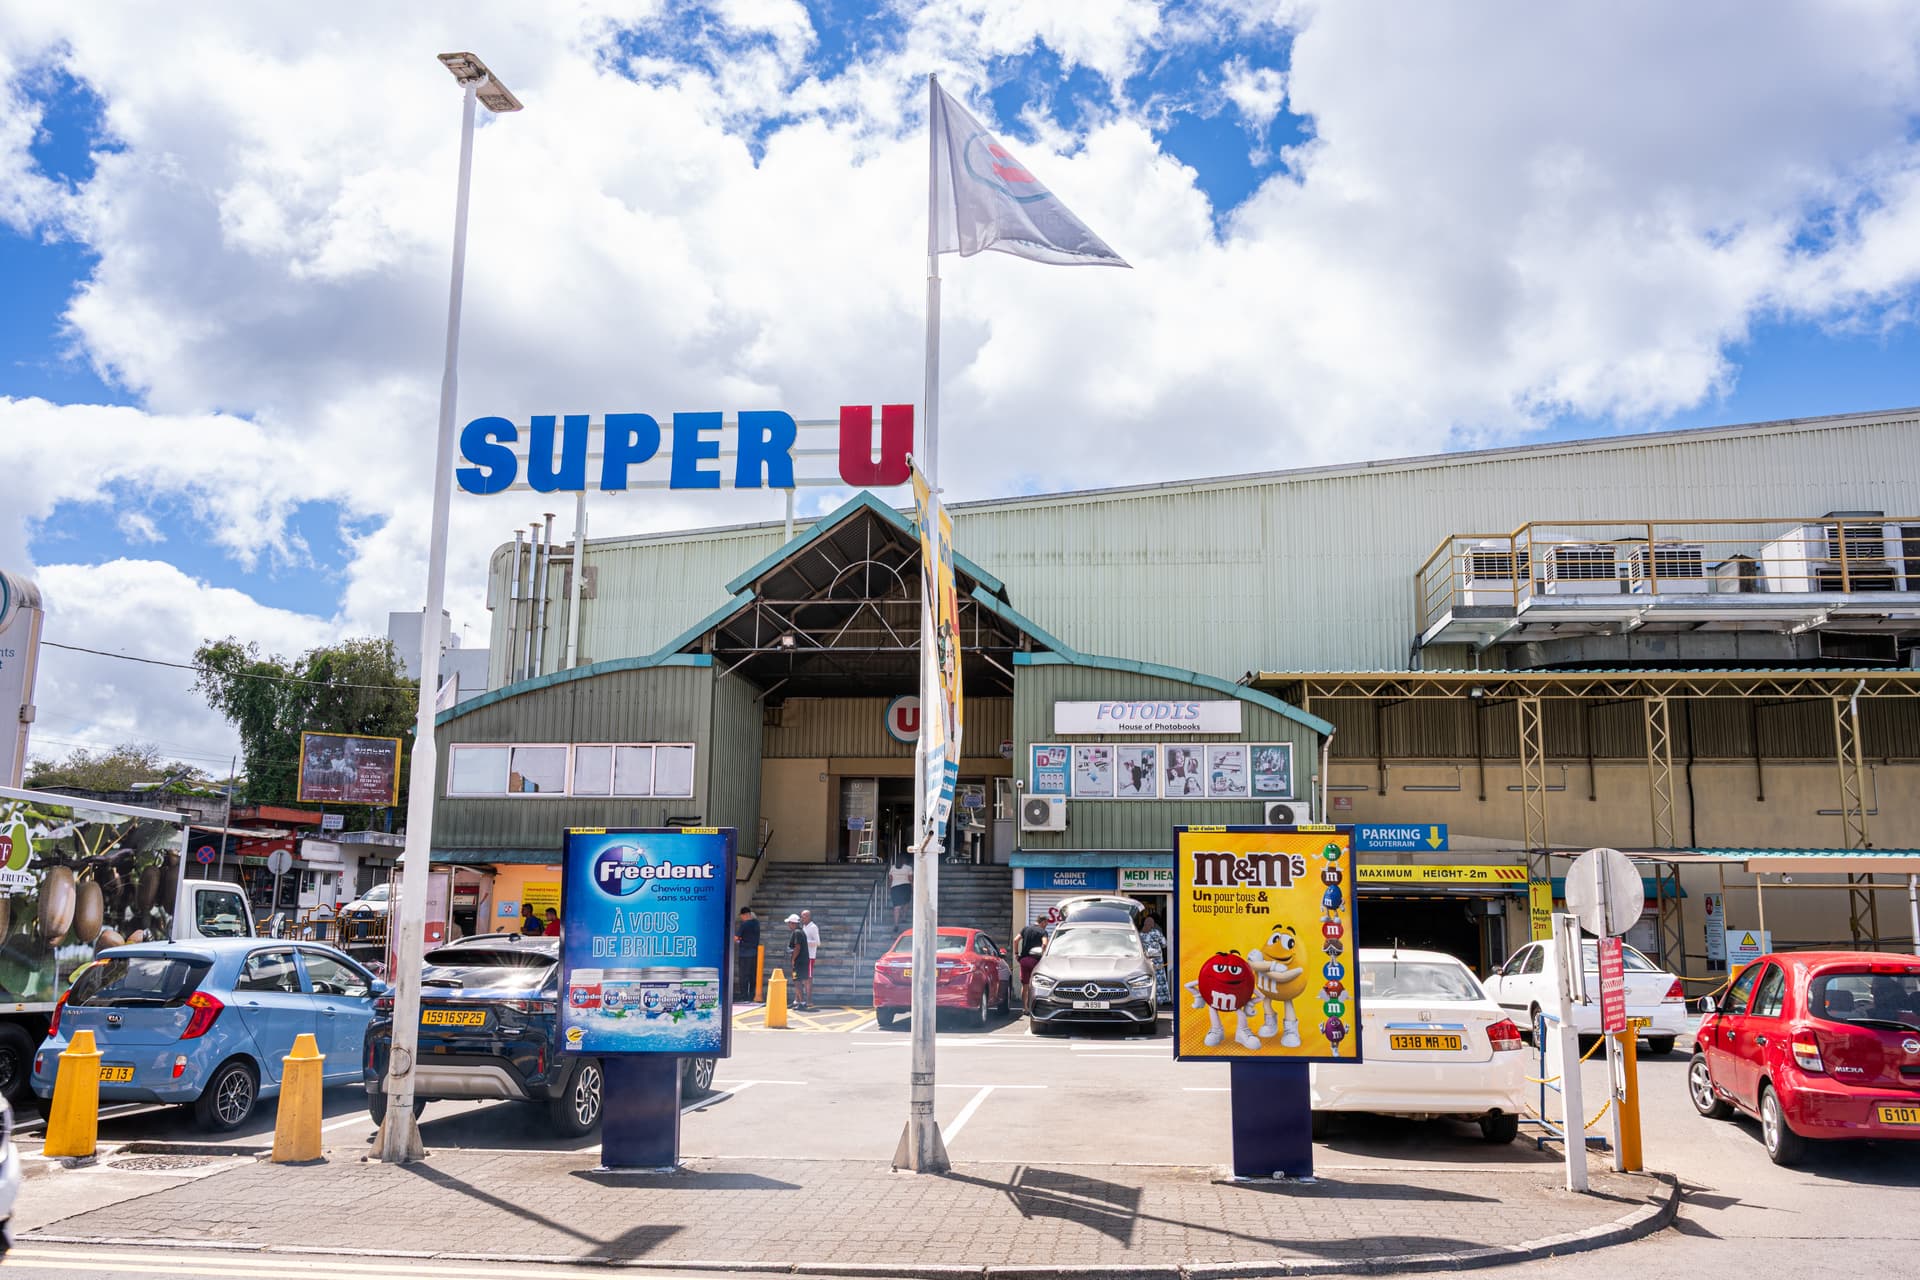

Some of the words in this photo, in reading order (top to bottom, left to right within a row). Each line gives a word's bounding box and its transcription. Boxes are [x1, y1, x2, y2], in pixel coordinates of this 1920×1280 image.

[455, 411, 798, 495] SUPER
[839, 404, 914, 487] U
[1097, 703, 1200, 720] FOTODIS
[897, 707, 921, 733] U
[1119, 723, 1143, 731] House
[1144, 723, 1153, 731] of
[1154, 723, 1200, 731] Photobooks
[1362, 828, 1421, 840] PARKING
[1368, 840, 1415, 848] SOUTERRAIN
[600, 861, 714, 882] Freedent
[1054, 871, 1086, 879] CABINET
[1124, 870, 1149, 881] MEDI
[1359, 869, 1412, 878] MAXIMUM
[650, 884, 691, 894] Chewing
[693, 886, 714, 895] gum
[1193, 890, 1212, 901] Un
[1214, 893, 1235, 904] pour
[1236, 892, 1256, 902] tous
[1257, 891, 1268, 902] &
[1193, 903, 1212, 913] tous
[1213, 905, 1234, 916] pour
[1235, 903, 1244, 914] le
[1245, 903, 1270, 914] fun
[612, 906, 626, 934] À
[629, 911, 680, 934] VOUS
[592, 936, 617, 958] DE
[621, 935, 697, 958] BRILLER
[1211, 989, 1237, 1011] m
[1395, 1036, 1422, 1048] 1318
[1444, 1037, 1457, 1049] 10
[100, 1067, 113, 1080] FB
[117, 1068, 129, 1080] 13
[1834, 1066, 1864, 1074] MICRA
[1884, 1108, 1917, 1122] 6101
